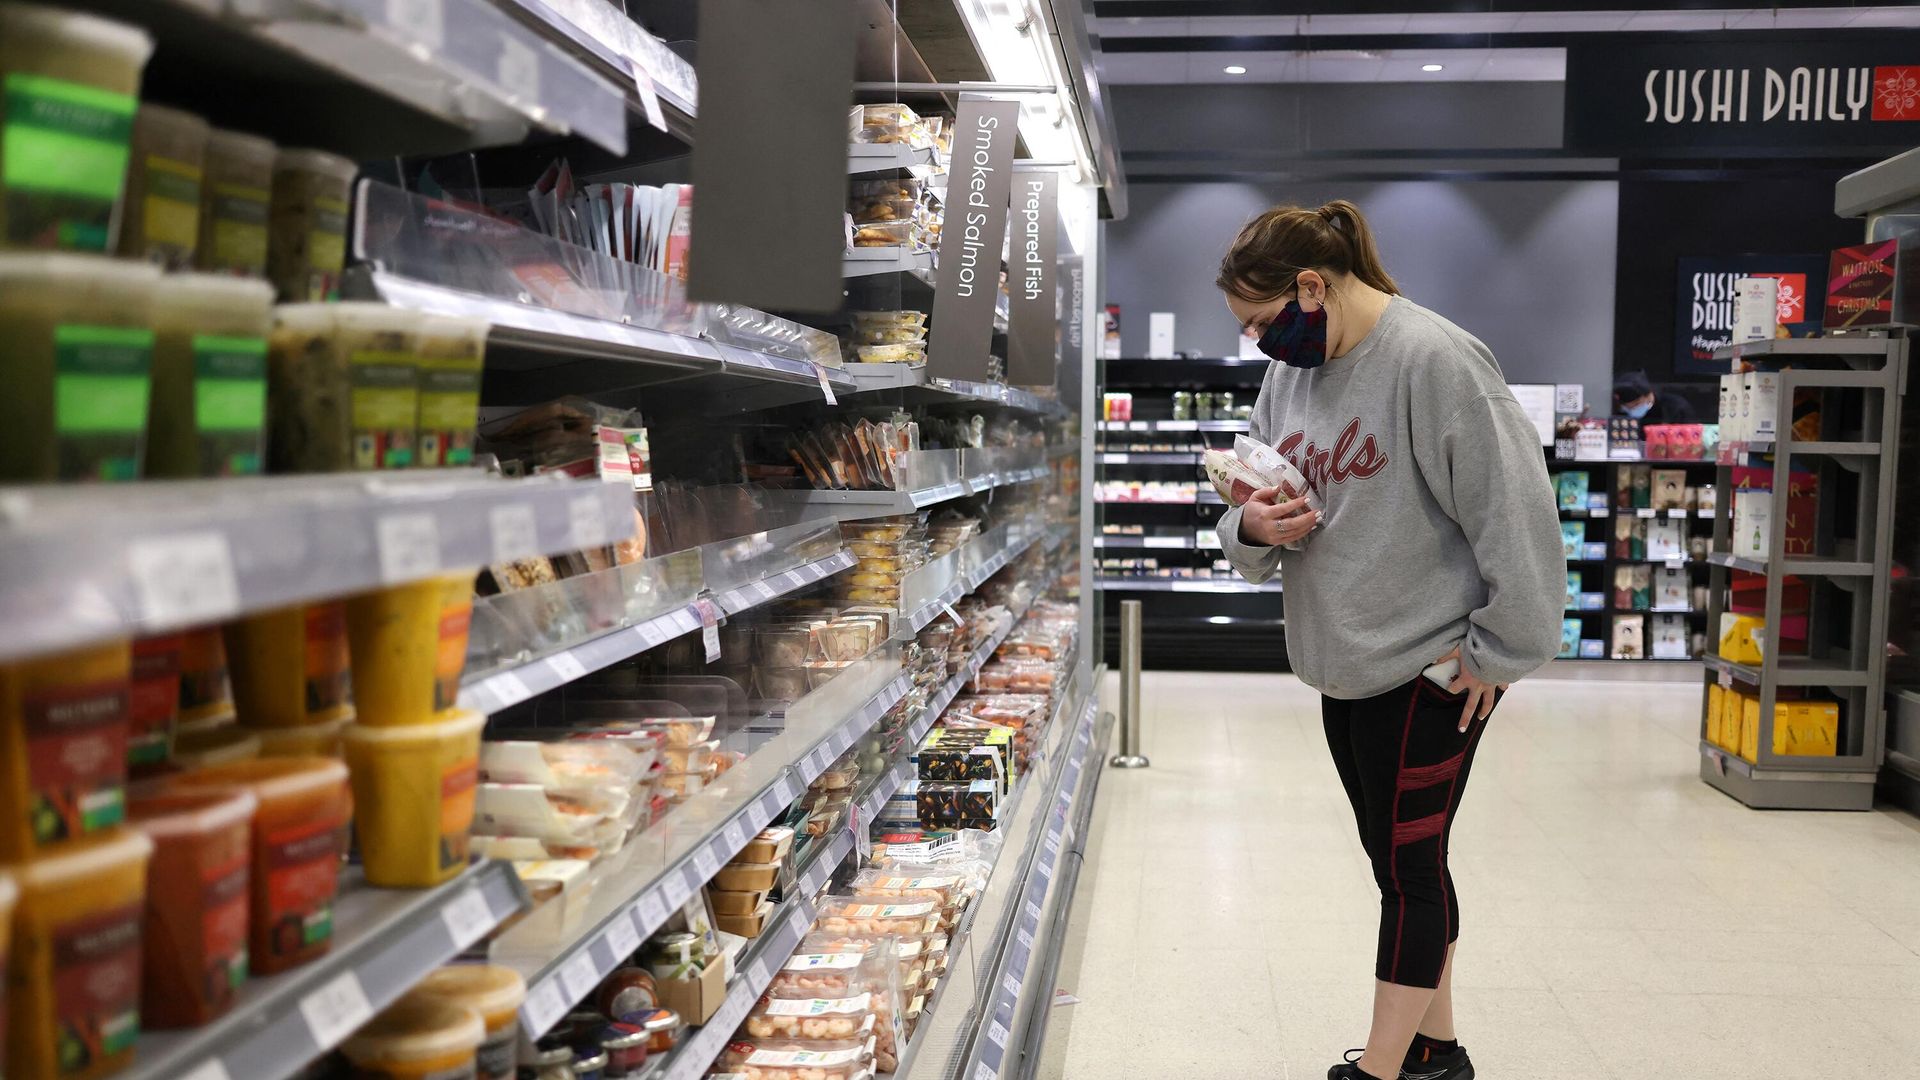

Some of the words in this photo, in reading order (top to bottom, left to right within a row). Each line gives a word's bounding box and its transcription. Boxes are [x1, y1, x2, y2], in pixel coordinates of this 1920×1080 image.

[1645, 69, 1750, 123] SUSHI
[1763, 67, 1870, 122] DAILY
[969, 115, 998, 209] Smoked
[1024, 181, 1044, 263] Prepared
[957, 213, 987, 298] Salmon
[1842, 258, 1884, 278] WAITROSE
[1025, 266, 1043, 301] Fish
[1692, 272, 1748, 302] SUSH
[1692, 301, 1733, 331] DAIL
[1838, 295, 1881, 314] CHRISTMAS
